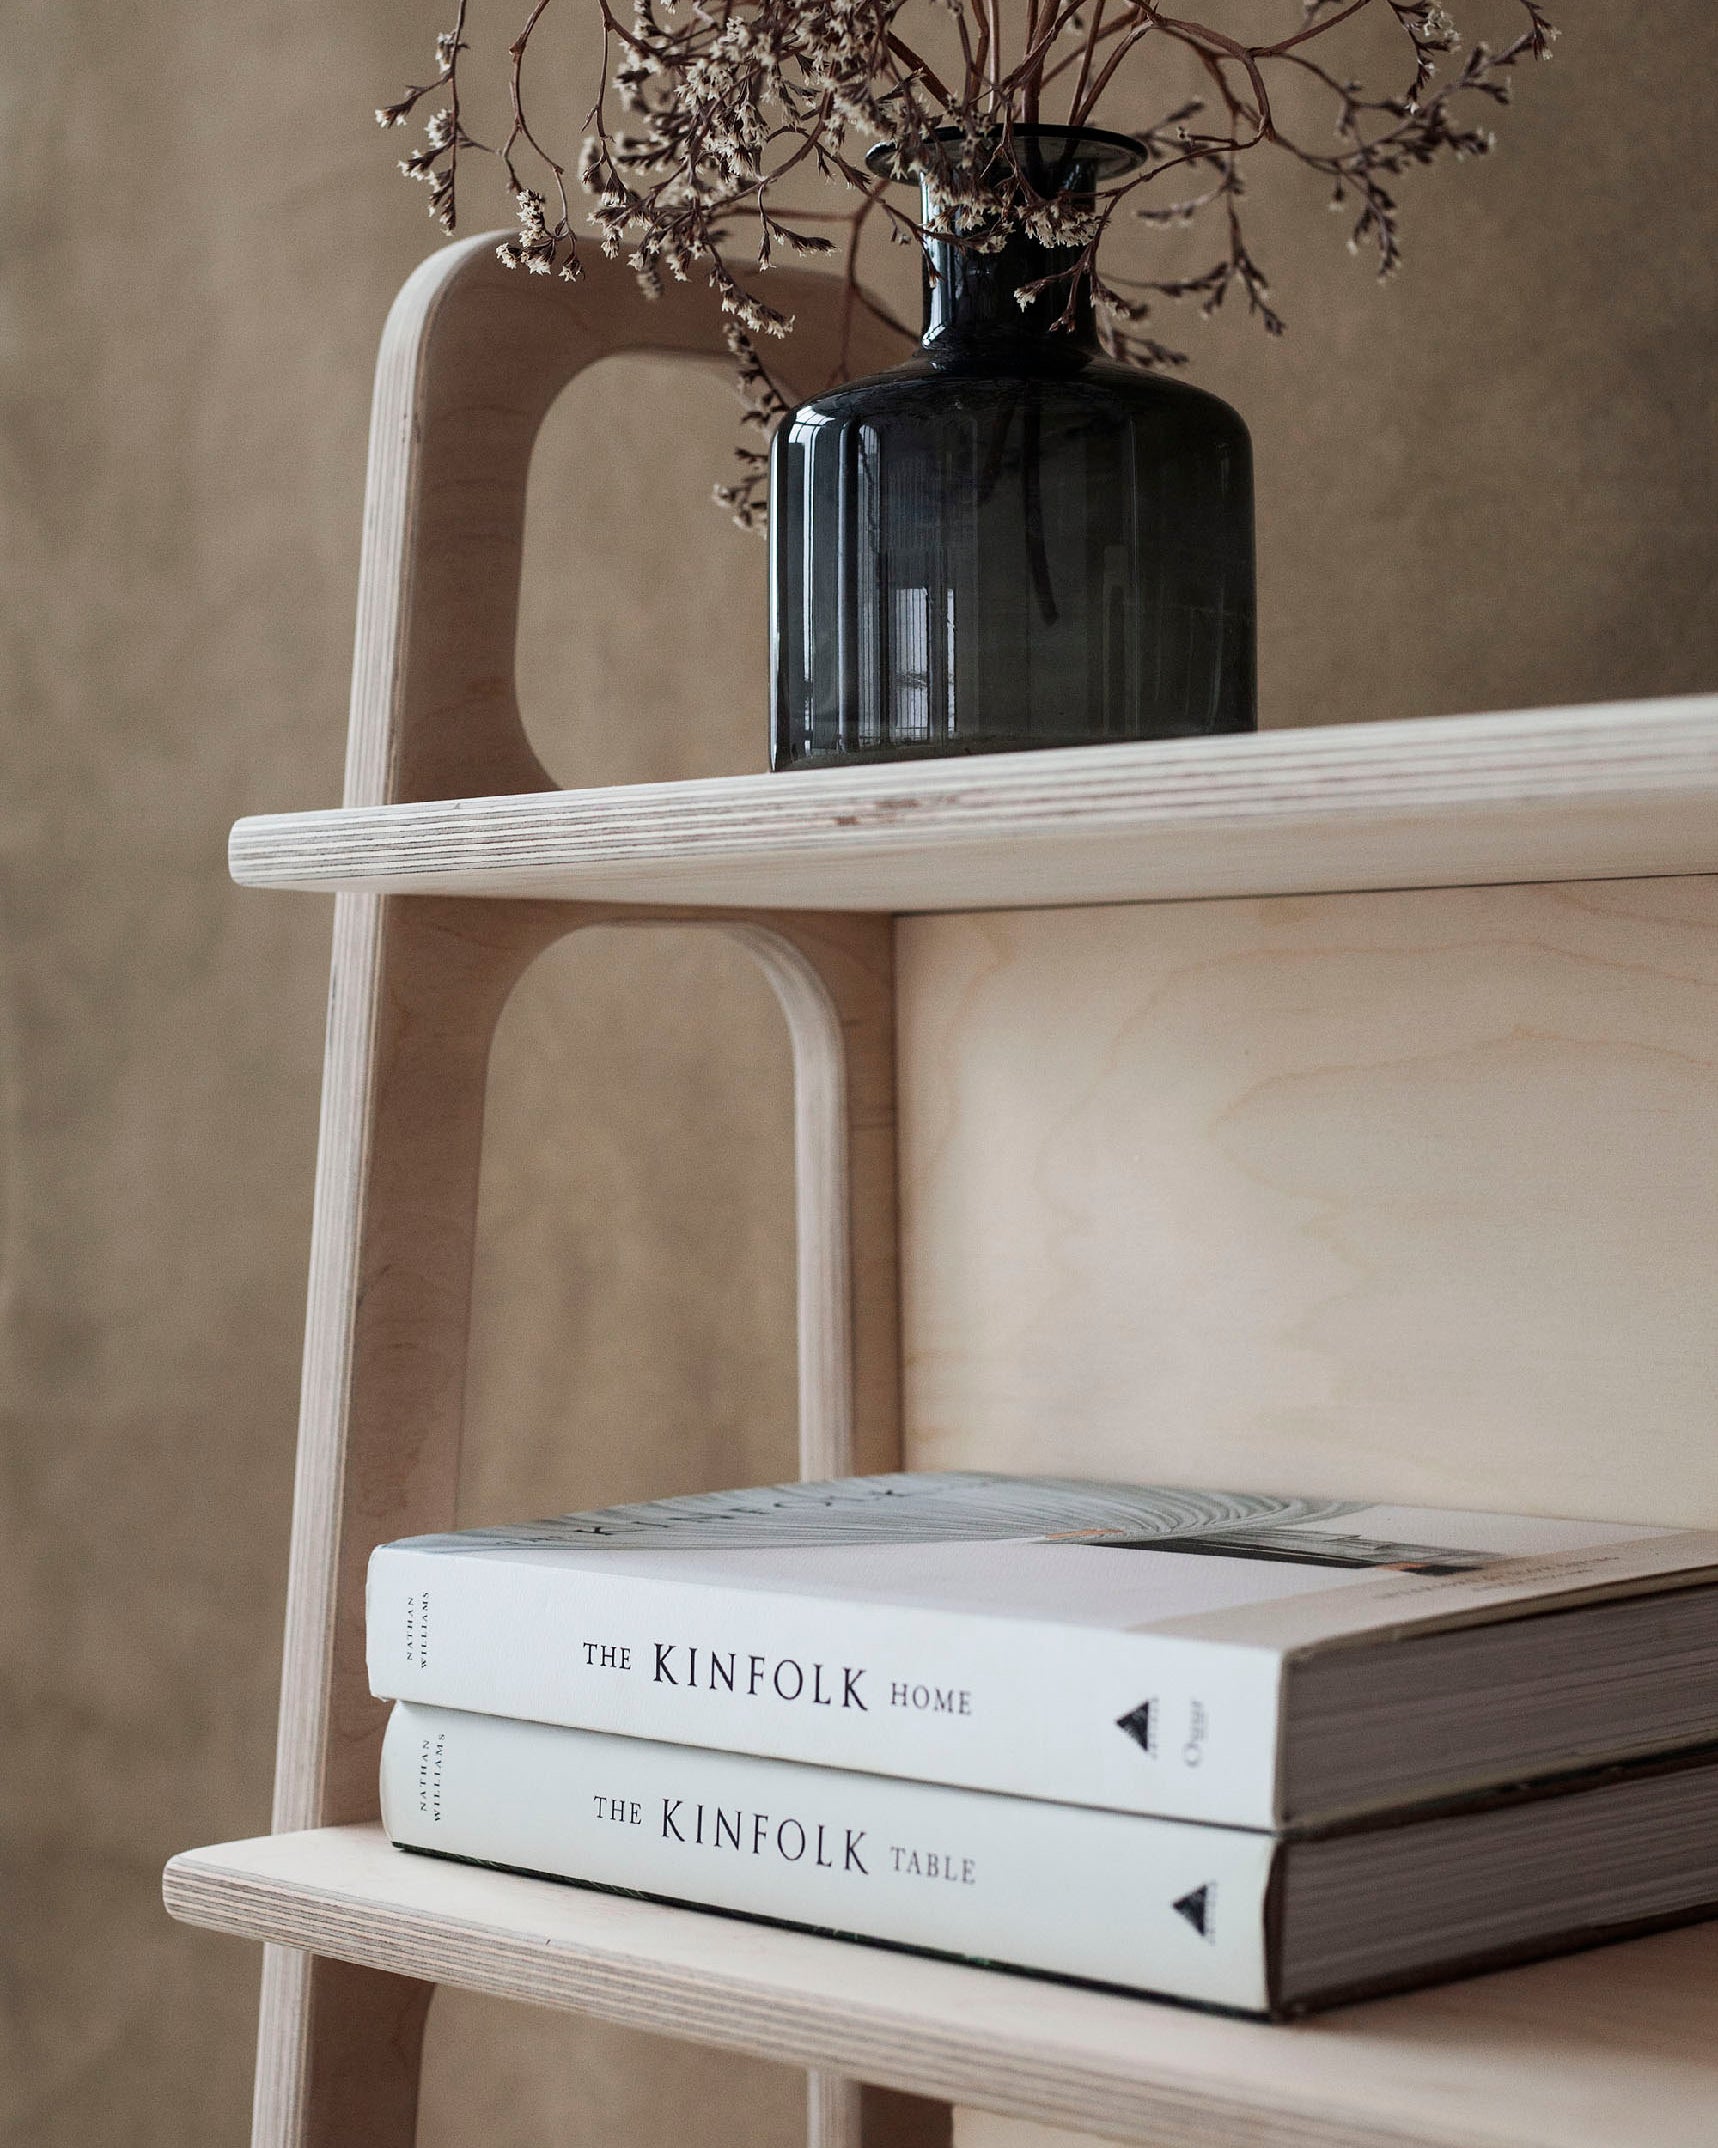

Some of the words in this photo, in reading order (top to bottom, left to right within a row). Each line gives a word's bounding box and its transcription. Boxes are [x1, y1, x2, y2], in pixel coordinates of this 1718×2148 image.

[405, 1597, 415, 1661] NATHAN
[420, 1591, 430, 1669] WILLIAMS
[582, 1641, 633, 1671] THE
[652, 1642, 869, 1712] KINFOLK
[890, 1682, 972, 1716] HOME
[419, 1740, 431, 1812] NATHAN
[433, 1733, 446, 1822] WILLIAMS
[592, 1795, 643, 1826] THE
[661, 1798, 869, 1875] KINFOLK
[890, 1846, 976, 1885] TABLE
